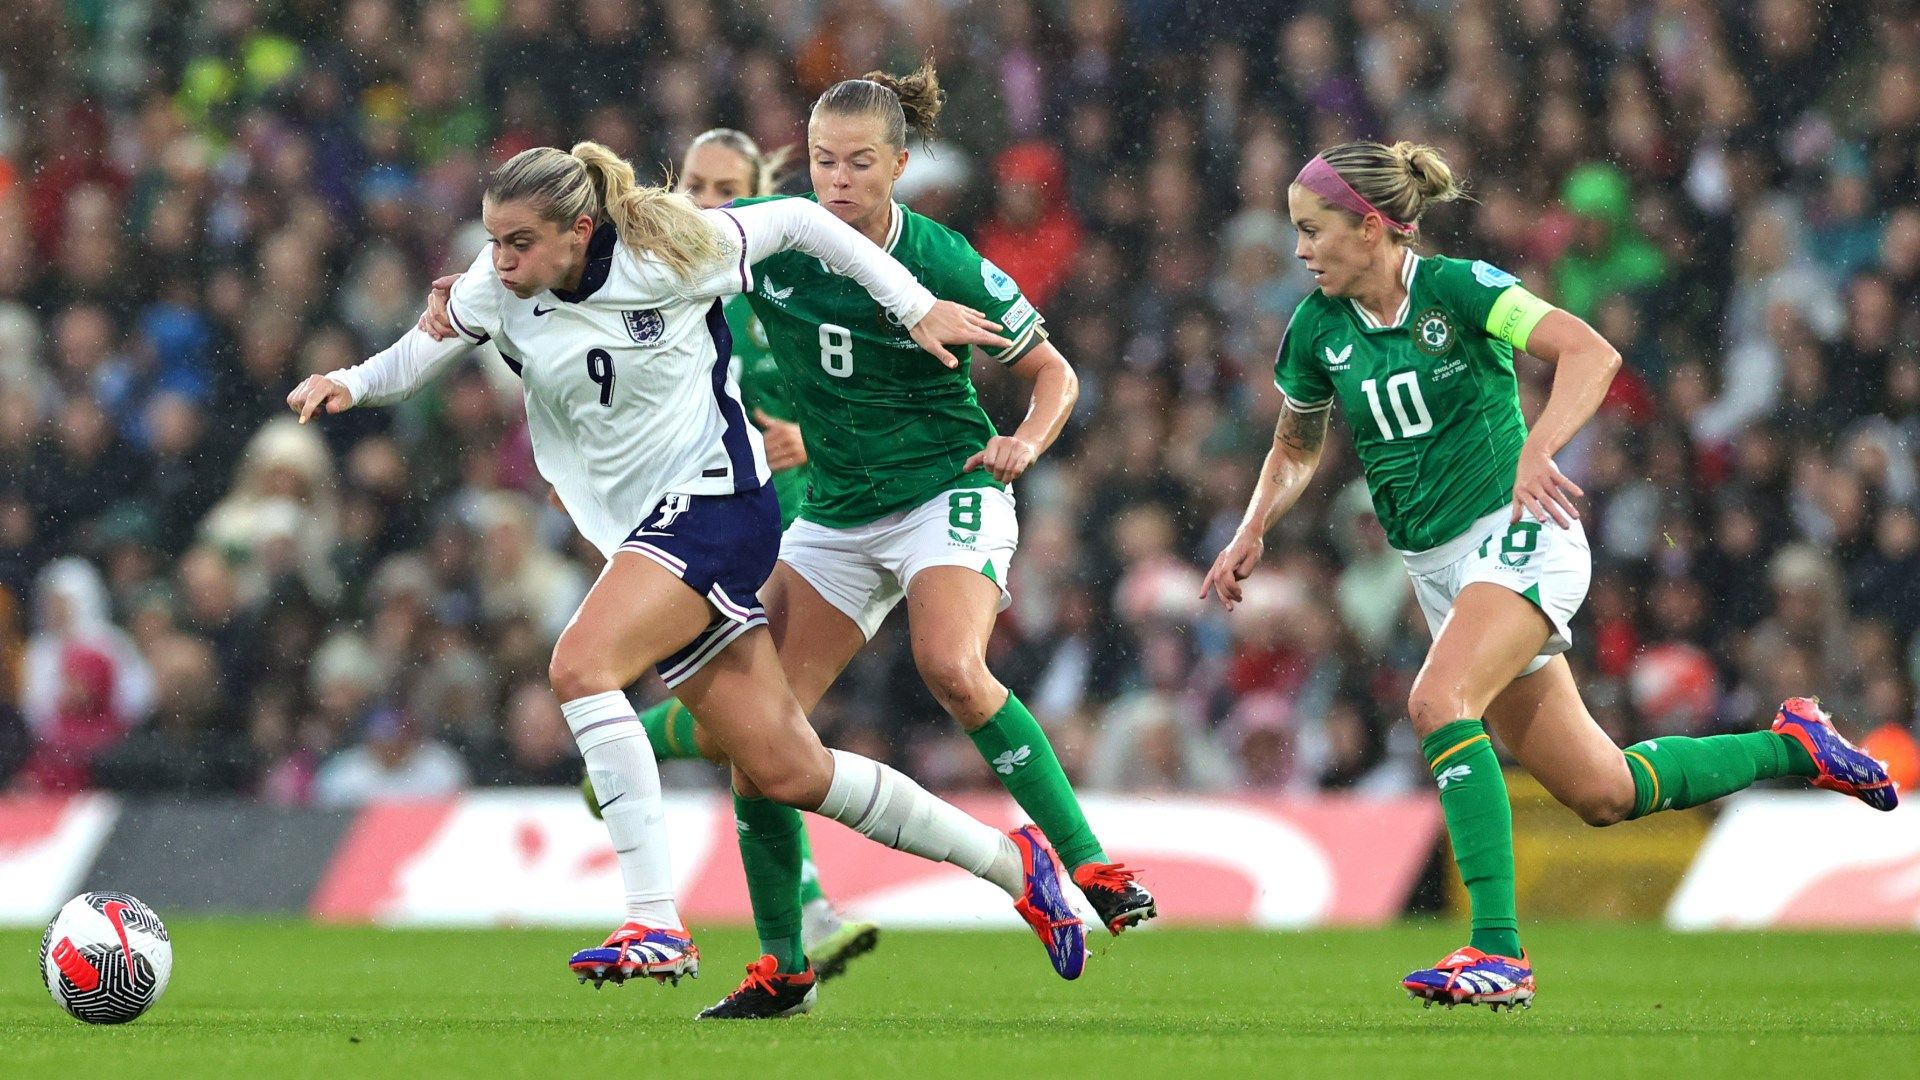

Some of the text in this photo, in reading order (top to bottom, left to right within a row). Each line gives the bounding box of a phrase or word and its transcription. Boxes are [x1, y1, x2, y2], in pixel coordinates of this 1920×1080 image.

[1502, 305, 1522, 341] SPECT
[818, 323, 854, 378] 8
[1433, 359, 1461, 375] ENGLAND
[586, 347, 616, 408] 9
[1361, 370, 1433, 441] 10
[948, 491, 982, 532] 8
